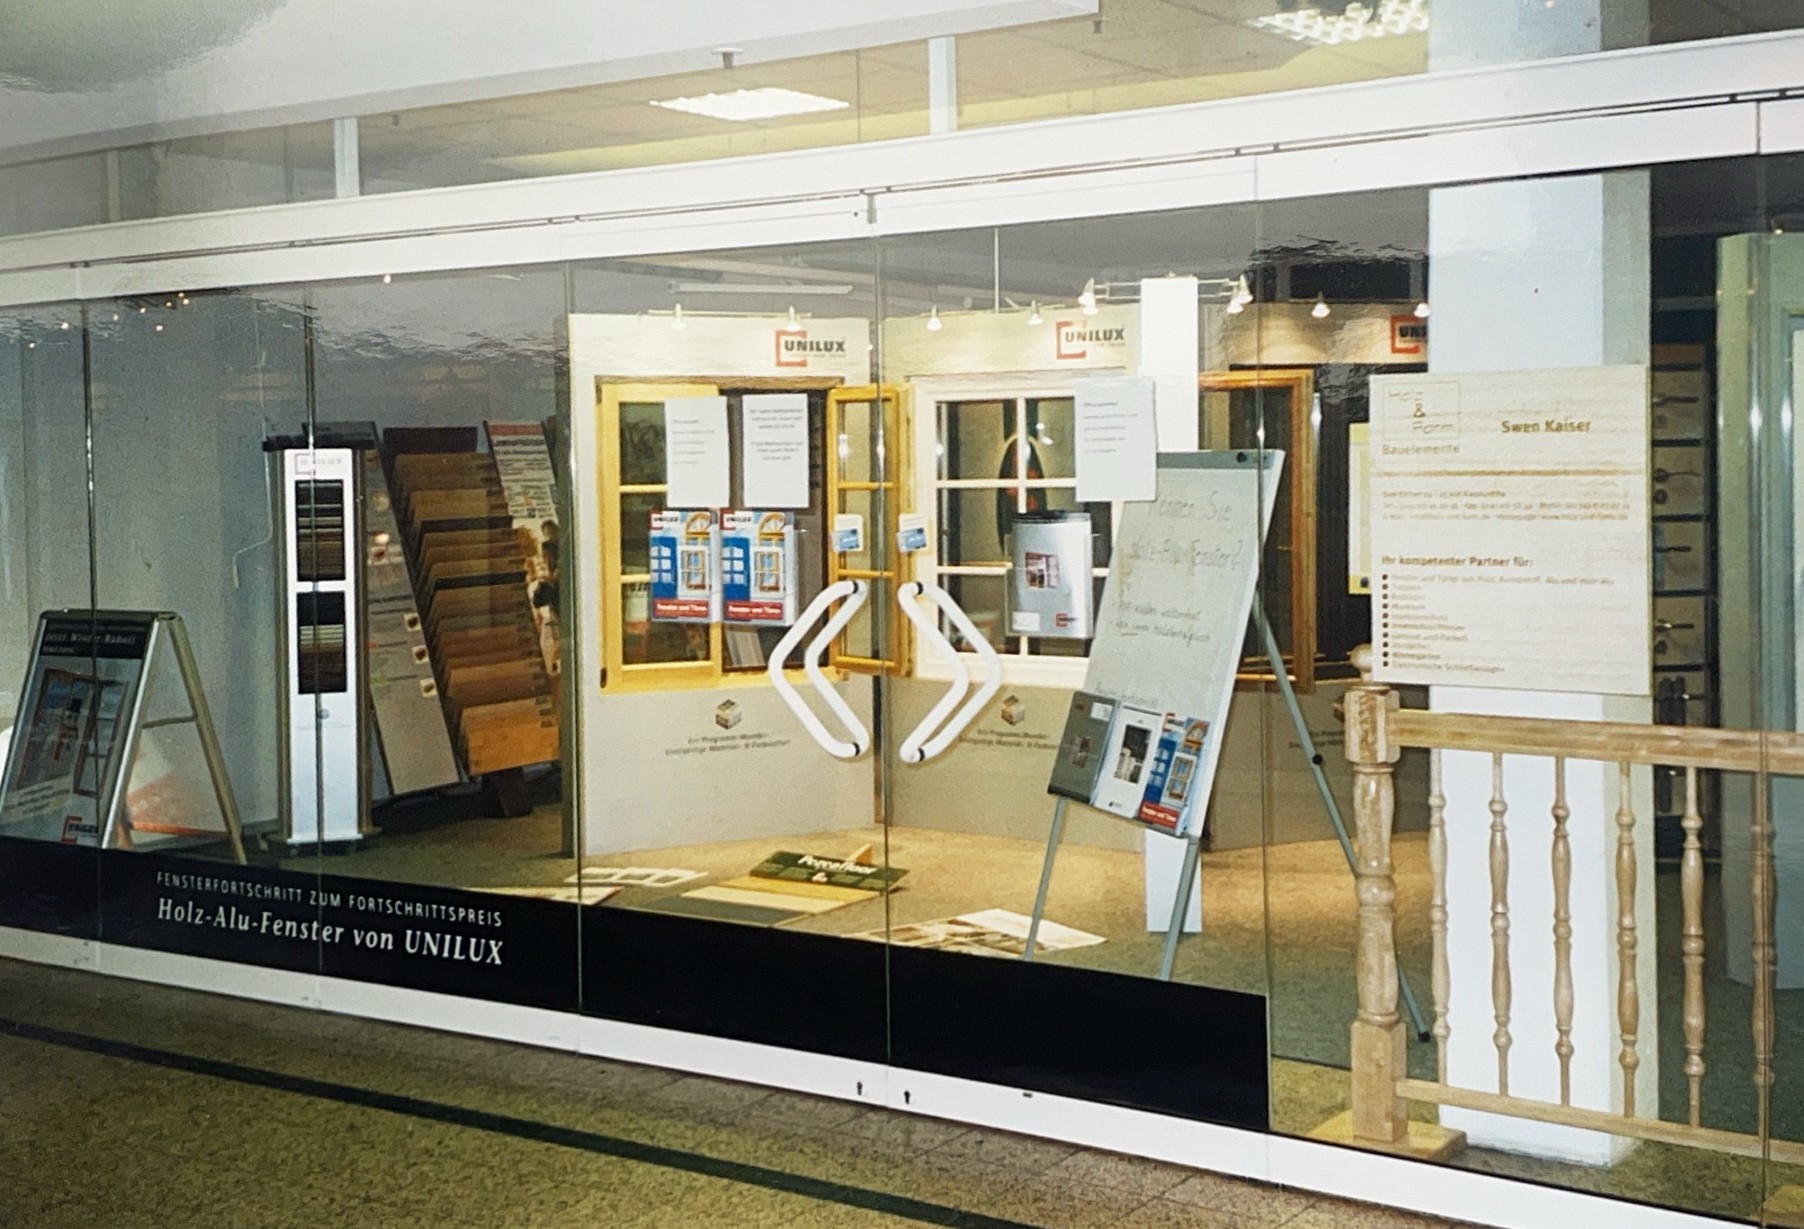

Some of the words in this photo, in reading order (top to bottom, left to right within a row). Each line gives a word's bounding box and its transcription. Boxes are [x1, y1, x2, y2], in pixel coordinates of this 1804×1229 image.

[1065, 328, 1125, 342] UNILUX
[784, 339, 845, 352] UNILUX
[1413, 402, 1426, 417] &
[1412, 421, 1454, 434] Form
[1501, 420, 1540, 434] Swen
[1545, 419, 1592, 434] Kaiser
[1382, 443, 1460, 455] Bauelemente
[1469, 556, 1509, 567] Partner
[157, 871, 302, 902] FENSTERFORTSCHRITT
[309, 890, 341, 907] ZUM
[349, 894, 502, 927] FORTSCHRITTSPREIS
[158, 897, 345, 944] Holz-Alu-Fenster
[353, 928, 394, 951] von
[405, 929, 504, 965] UNILUX
